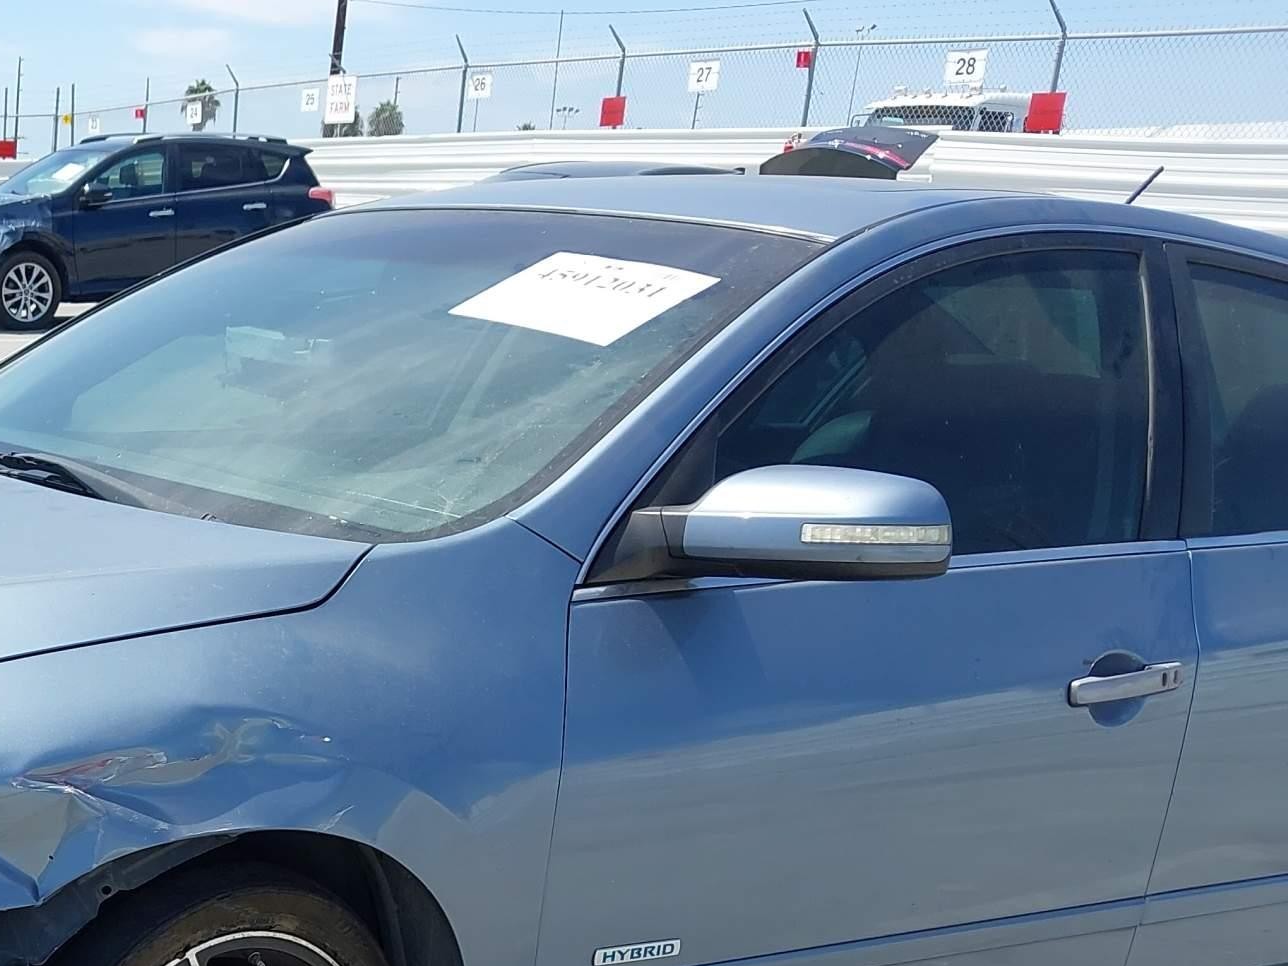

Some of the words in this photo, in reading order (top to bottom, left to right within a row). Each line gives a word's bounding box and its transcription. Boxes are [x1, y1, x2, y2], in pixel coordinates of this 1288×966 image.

[955, 57, 976, 76] 28
[696, 67, 712, 83] 27
[331, 84, 352, 96] STATE
[474, 77, 486, 91] 26
[305, 94, 315, 105] 25
[190, 107, 198, 118] 24
[329, 102, 350, 113] FARM
[602, 943, 675, 963] HYBRID
